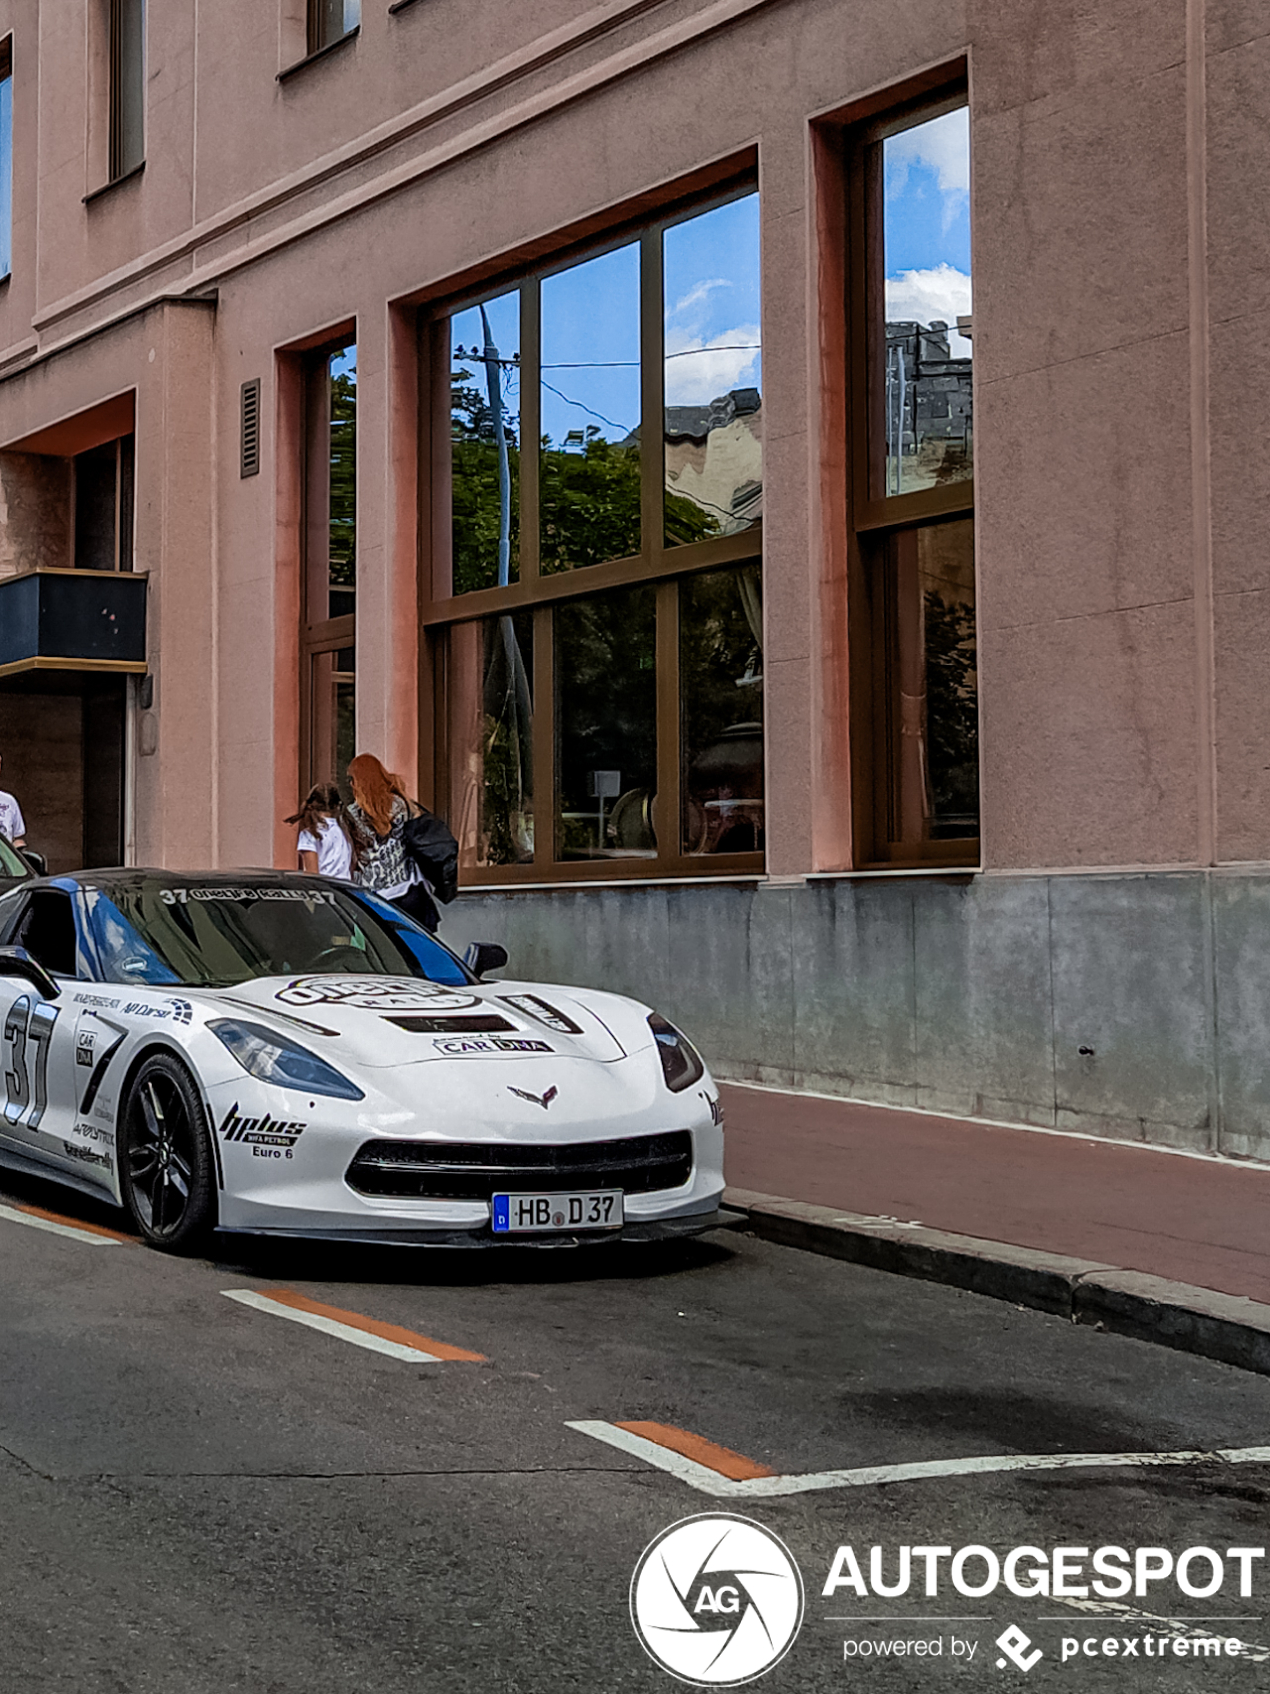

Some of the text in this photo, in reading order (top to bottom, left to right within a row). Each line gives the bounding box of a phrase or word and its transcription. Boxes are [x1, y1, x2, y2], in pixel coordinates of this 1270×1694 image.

[159, 889, 188, 904] 37
[308, 890, 336, 905] 37
[79, 1033, 95, 1047] CAR
[443, 1040, 549, 1053] CAR DNA
[3, 994, 61, 1133] 37
[219, 1101, 307, 1142] hplus
[252, 1147, 294, 1160] Euro 6
[518, 1196, 614, 1225] HB D 37
